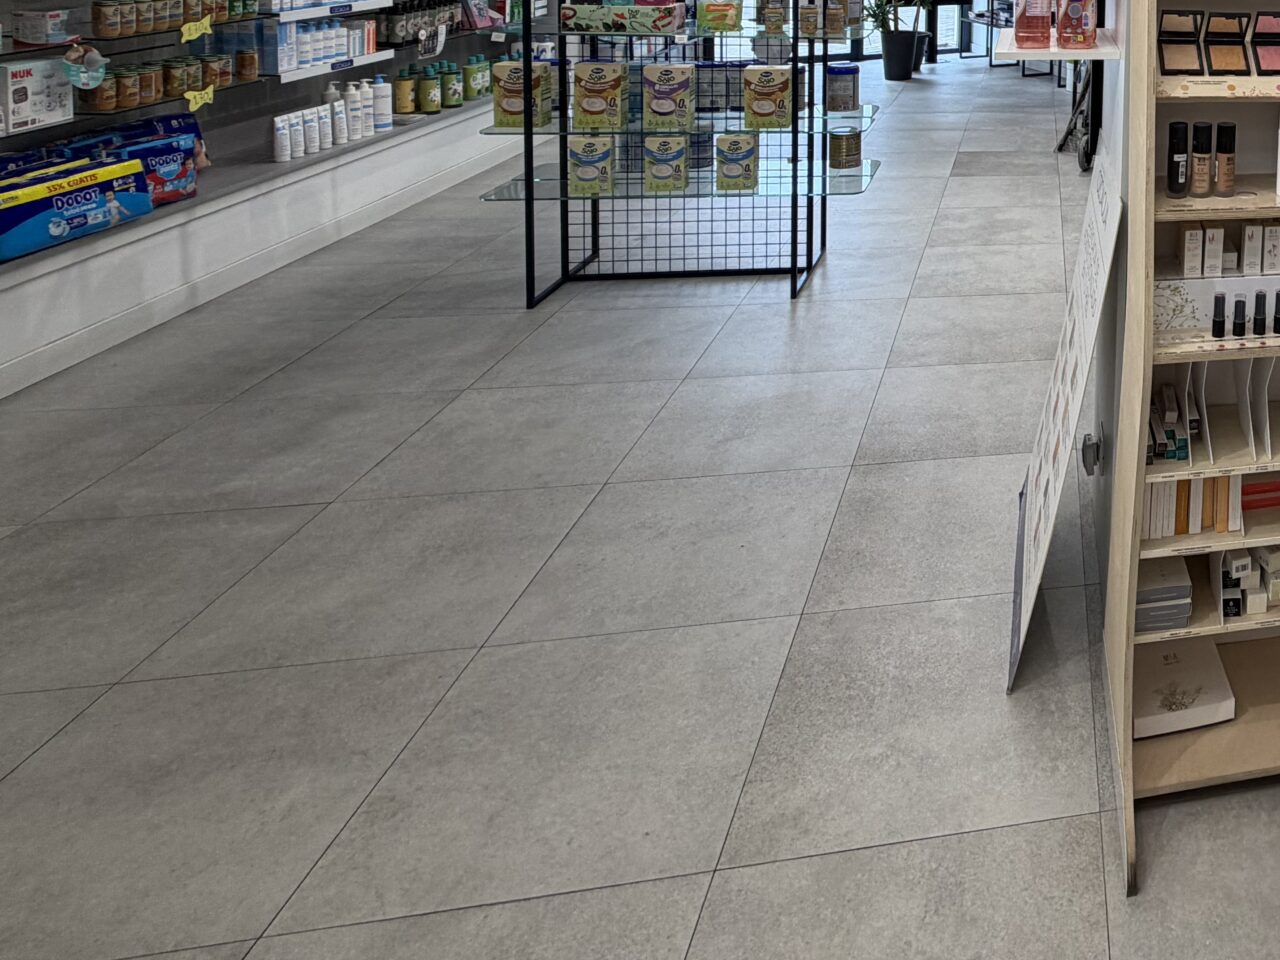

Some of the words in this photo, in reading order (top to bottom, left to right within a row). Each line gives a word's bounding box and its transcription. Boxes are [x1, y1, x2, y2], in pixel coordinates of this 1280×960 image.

[11, 67, 33, 81] NUK
[148, 152, 185, 170] DODOT
[53, 187, 100, 211] DODOT
